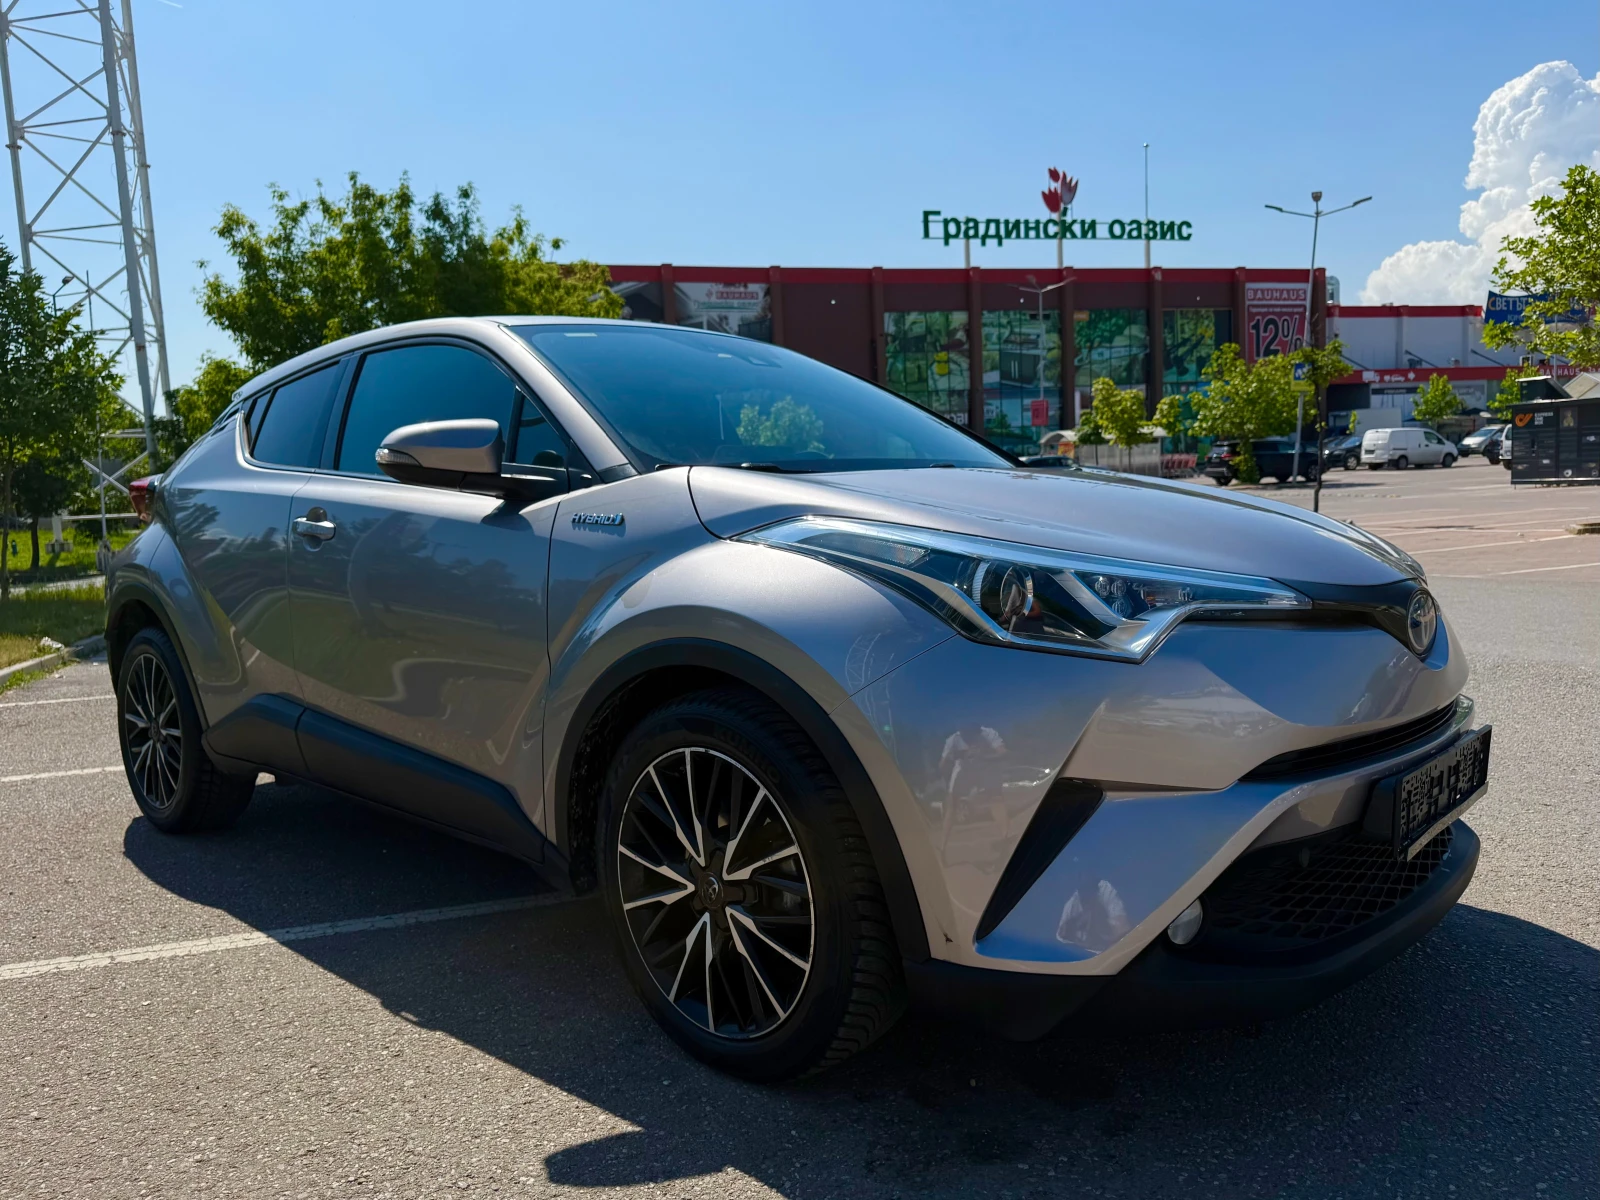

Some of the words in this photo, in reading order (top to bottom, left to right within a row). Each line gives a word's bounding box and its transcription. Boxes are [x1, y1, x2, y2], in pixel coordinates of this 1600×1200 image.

[923, 210, 1097, 247] Градински
[1108, 218, 1193, 240] оазис
[716, 291, 759, 300] BAUHAUS
[1247, 290, 1305, 300] BAUHAUS
[1250, 315, 1304, 359] 12%
[572, 512, 614, 525] HYBRID
